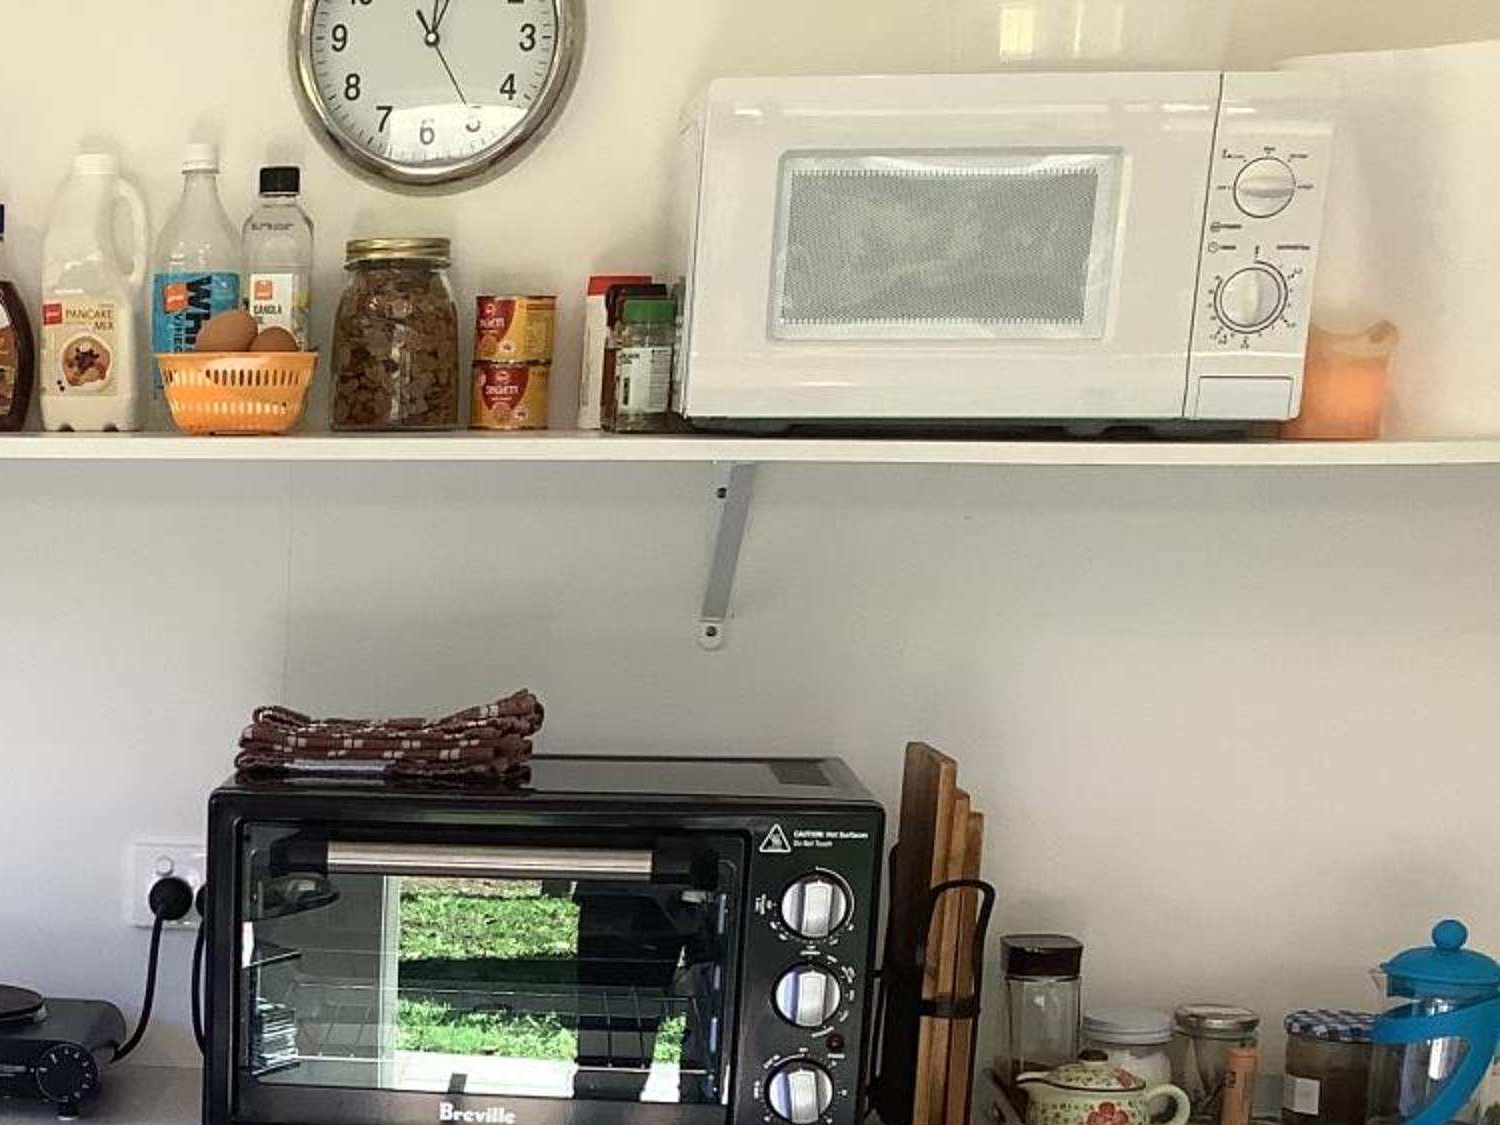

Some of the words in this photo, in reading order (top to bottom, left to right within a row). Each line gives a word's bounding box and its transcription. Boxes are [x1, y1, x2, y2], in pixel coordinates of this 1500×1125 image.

[331, 24, 348, 52] 9
[519, 23, 536, 51] 3
[344, 73, 361, 101] 8
[500, 74, 517, 101] 4
[376, 105, 393, 132] 7
[419, 118, 435, 145] 6
[439, 1101, 517, 1125] Breville
